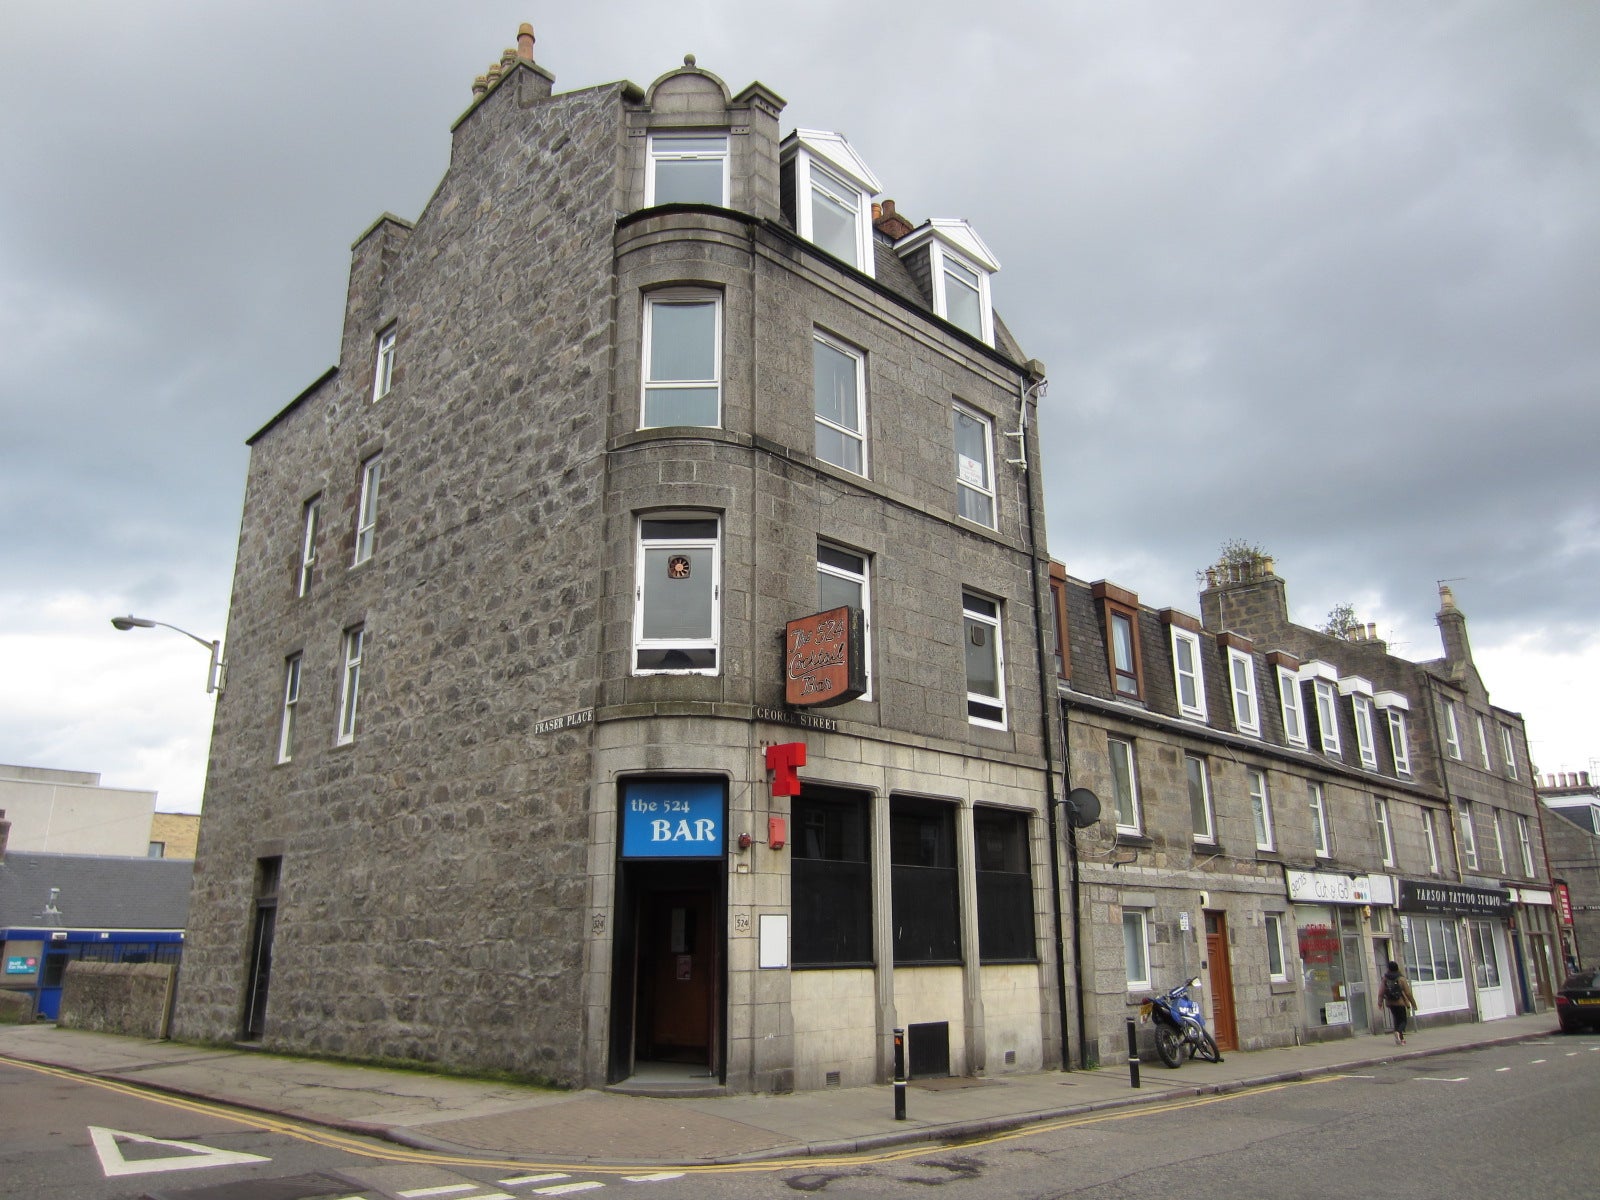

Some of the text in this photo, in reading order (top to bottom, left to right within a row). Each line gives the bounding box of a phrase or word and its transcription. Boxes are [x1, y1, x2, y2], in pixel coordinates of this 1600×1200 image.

[789, 618, 846, 654] The 524
[788, 642, 845, 680] Cocktail
[801, 675, 832, 696] Bar
[535, 710, 593, 734] FRASER PLACE
[800, 715, 838, 731] STREET
[631, 799, 691, 814] the 524
[651, 818, 716, 842] BAR
[1449, 891, 1475, 907] TATTOO
[1477, 894, 1501, 907] STUDIO
[736, 919, 749, 928] 524
